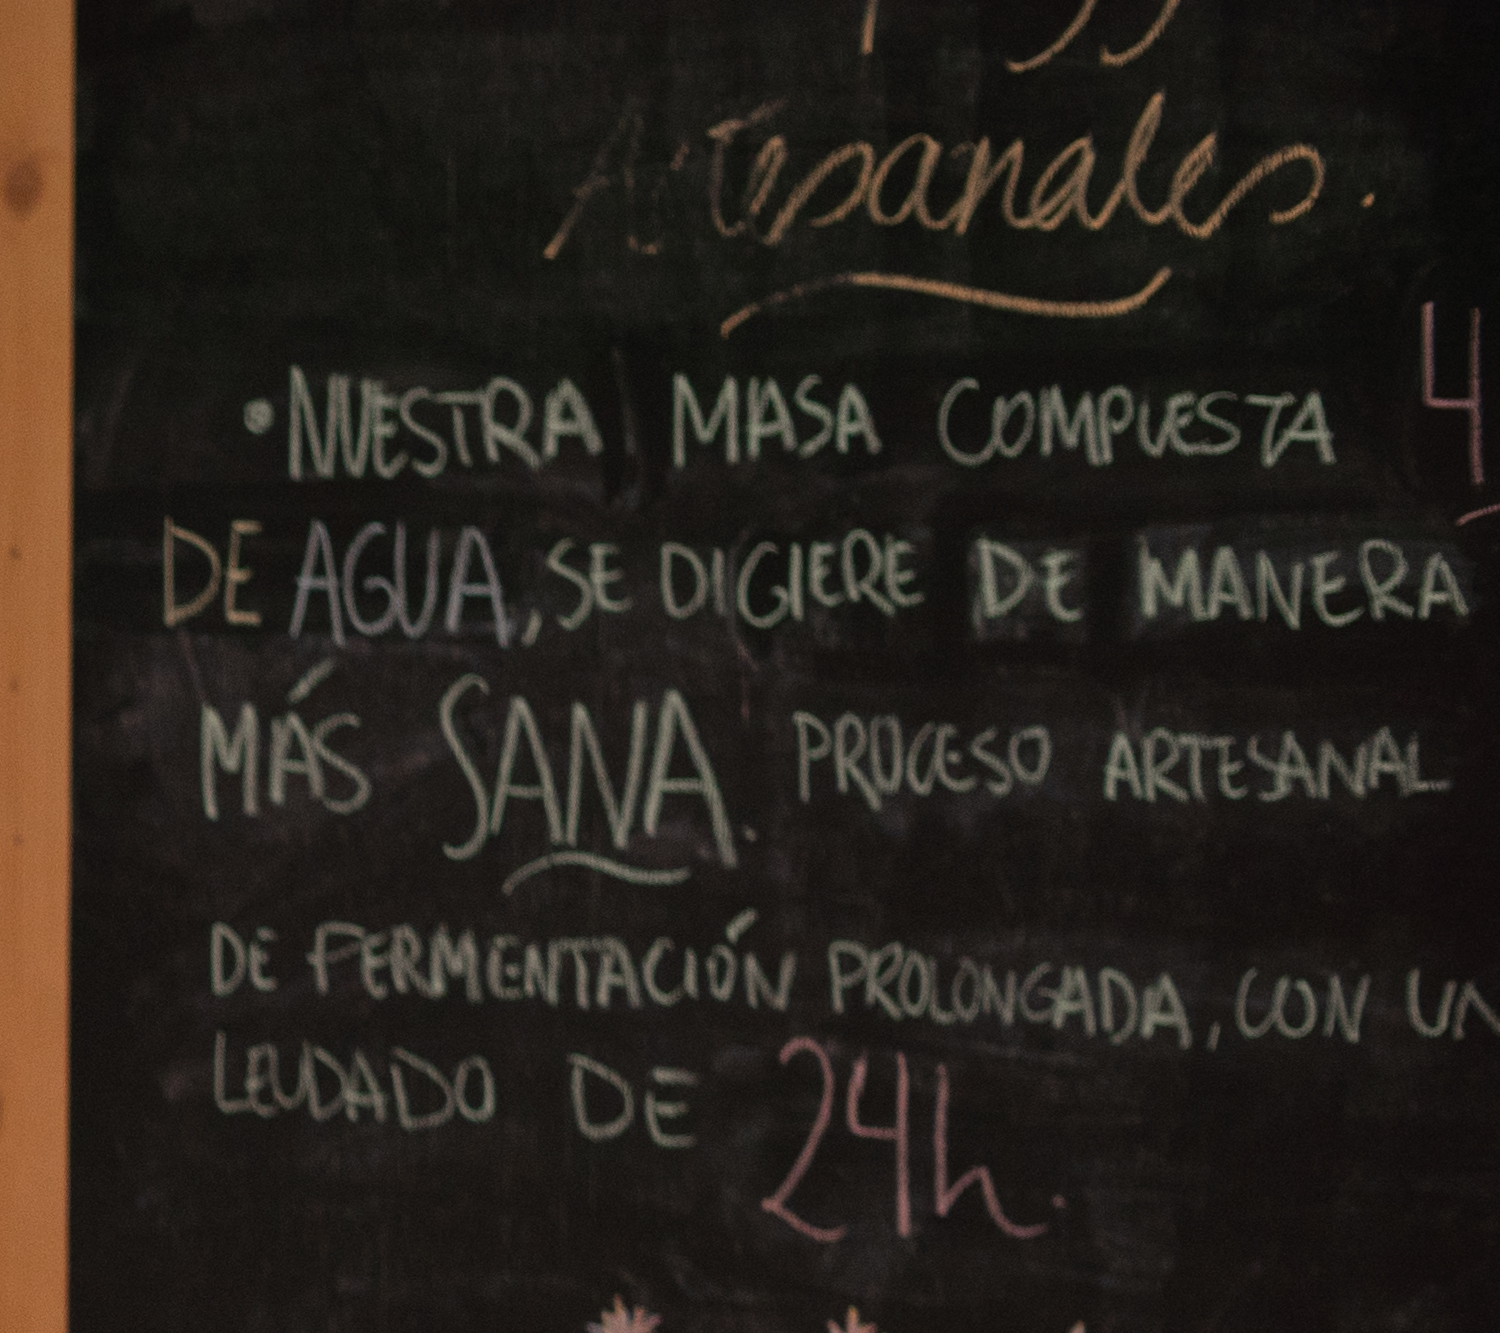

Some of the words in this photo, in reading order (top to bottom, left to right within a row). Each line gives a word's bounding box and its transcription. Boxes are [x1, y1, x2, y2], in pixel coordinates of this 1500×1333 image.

[288, 365, 602, 480] NUESTRA
[672, 373, 883, 468] MASA
[938, 376, 1337, 467] COMPUESTA
[163, 516, 263, 629] DE
[545, 537, 633, 631] SE
[659, 528, 925, 630] DIGIERE
[975, 537, 1085, 626] DE
[1140, 534, 1470, 630] MANERA
[201, 657, 373, 821] MÁS
[793, 710, 1052, 811] PROCESO
[210, 920, 279, 996] DE
[308, 908, 799, 1012] FERMENTACIÓN
[1234, 966, 1370, 1043] CON
[212, 1030, 497, 1131] LEUDADO
[566, 1052, 699, 1148] DE
